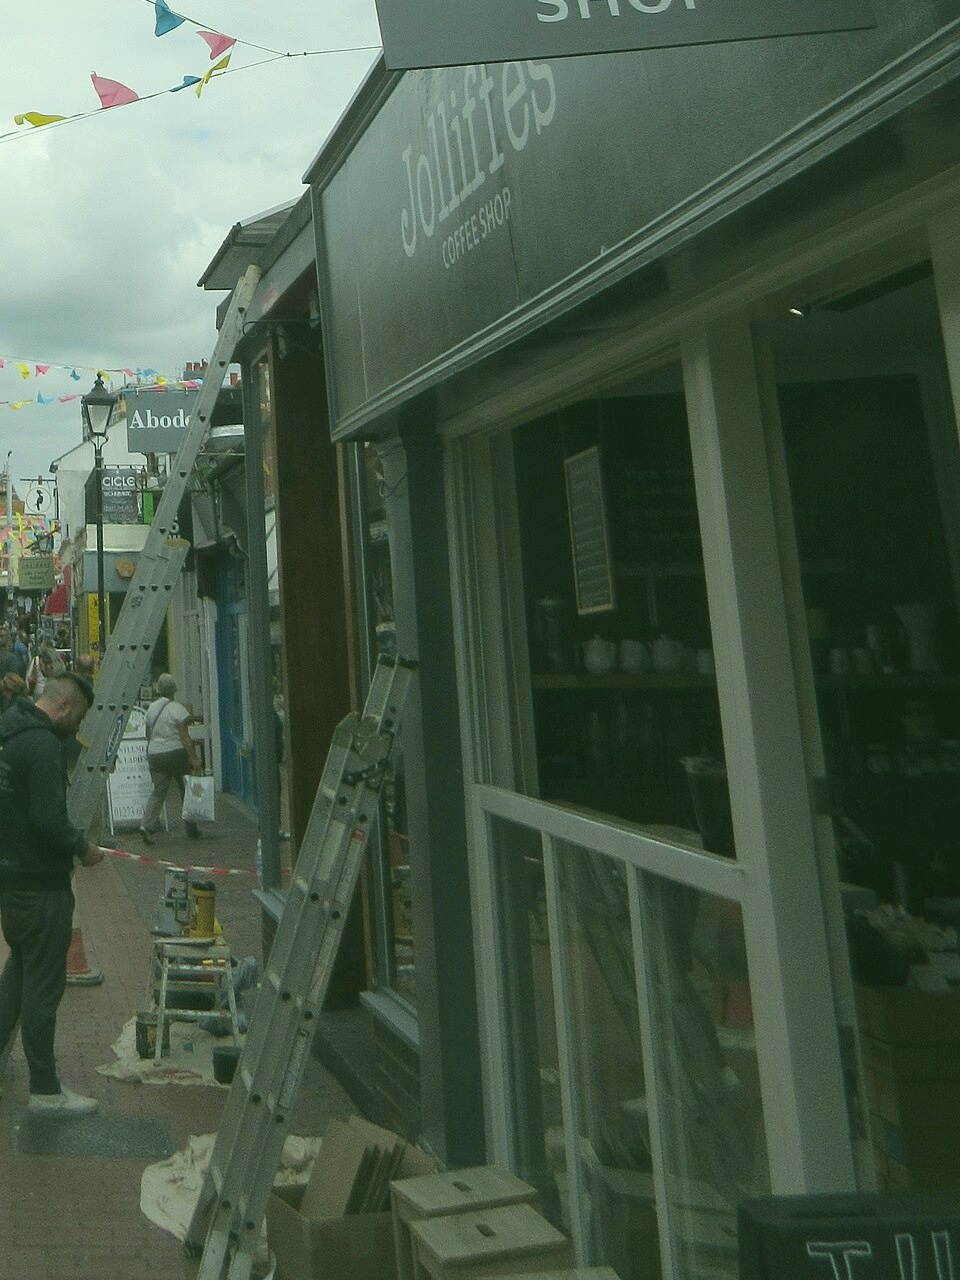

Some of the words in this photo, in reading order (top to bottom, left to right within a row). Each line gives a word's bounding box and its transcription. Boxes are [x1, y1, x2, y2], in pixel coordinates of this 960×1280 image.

[400, 59, 557, 258] Jolliffes
[442, 214, 480, 270] COFFEE
[478, 186, 512, 239] SHOP
